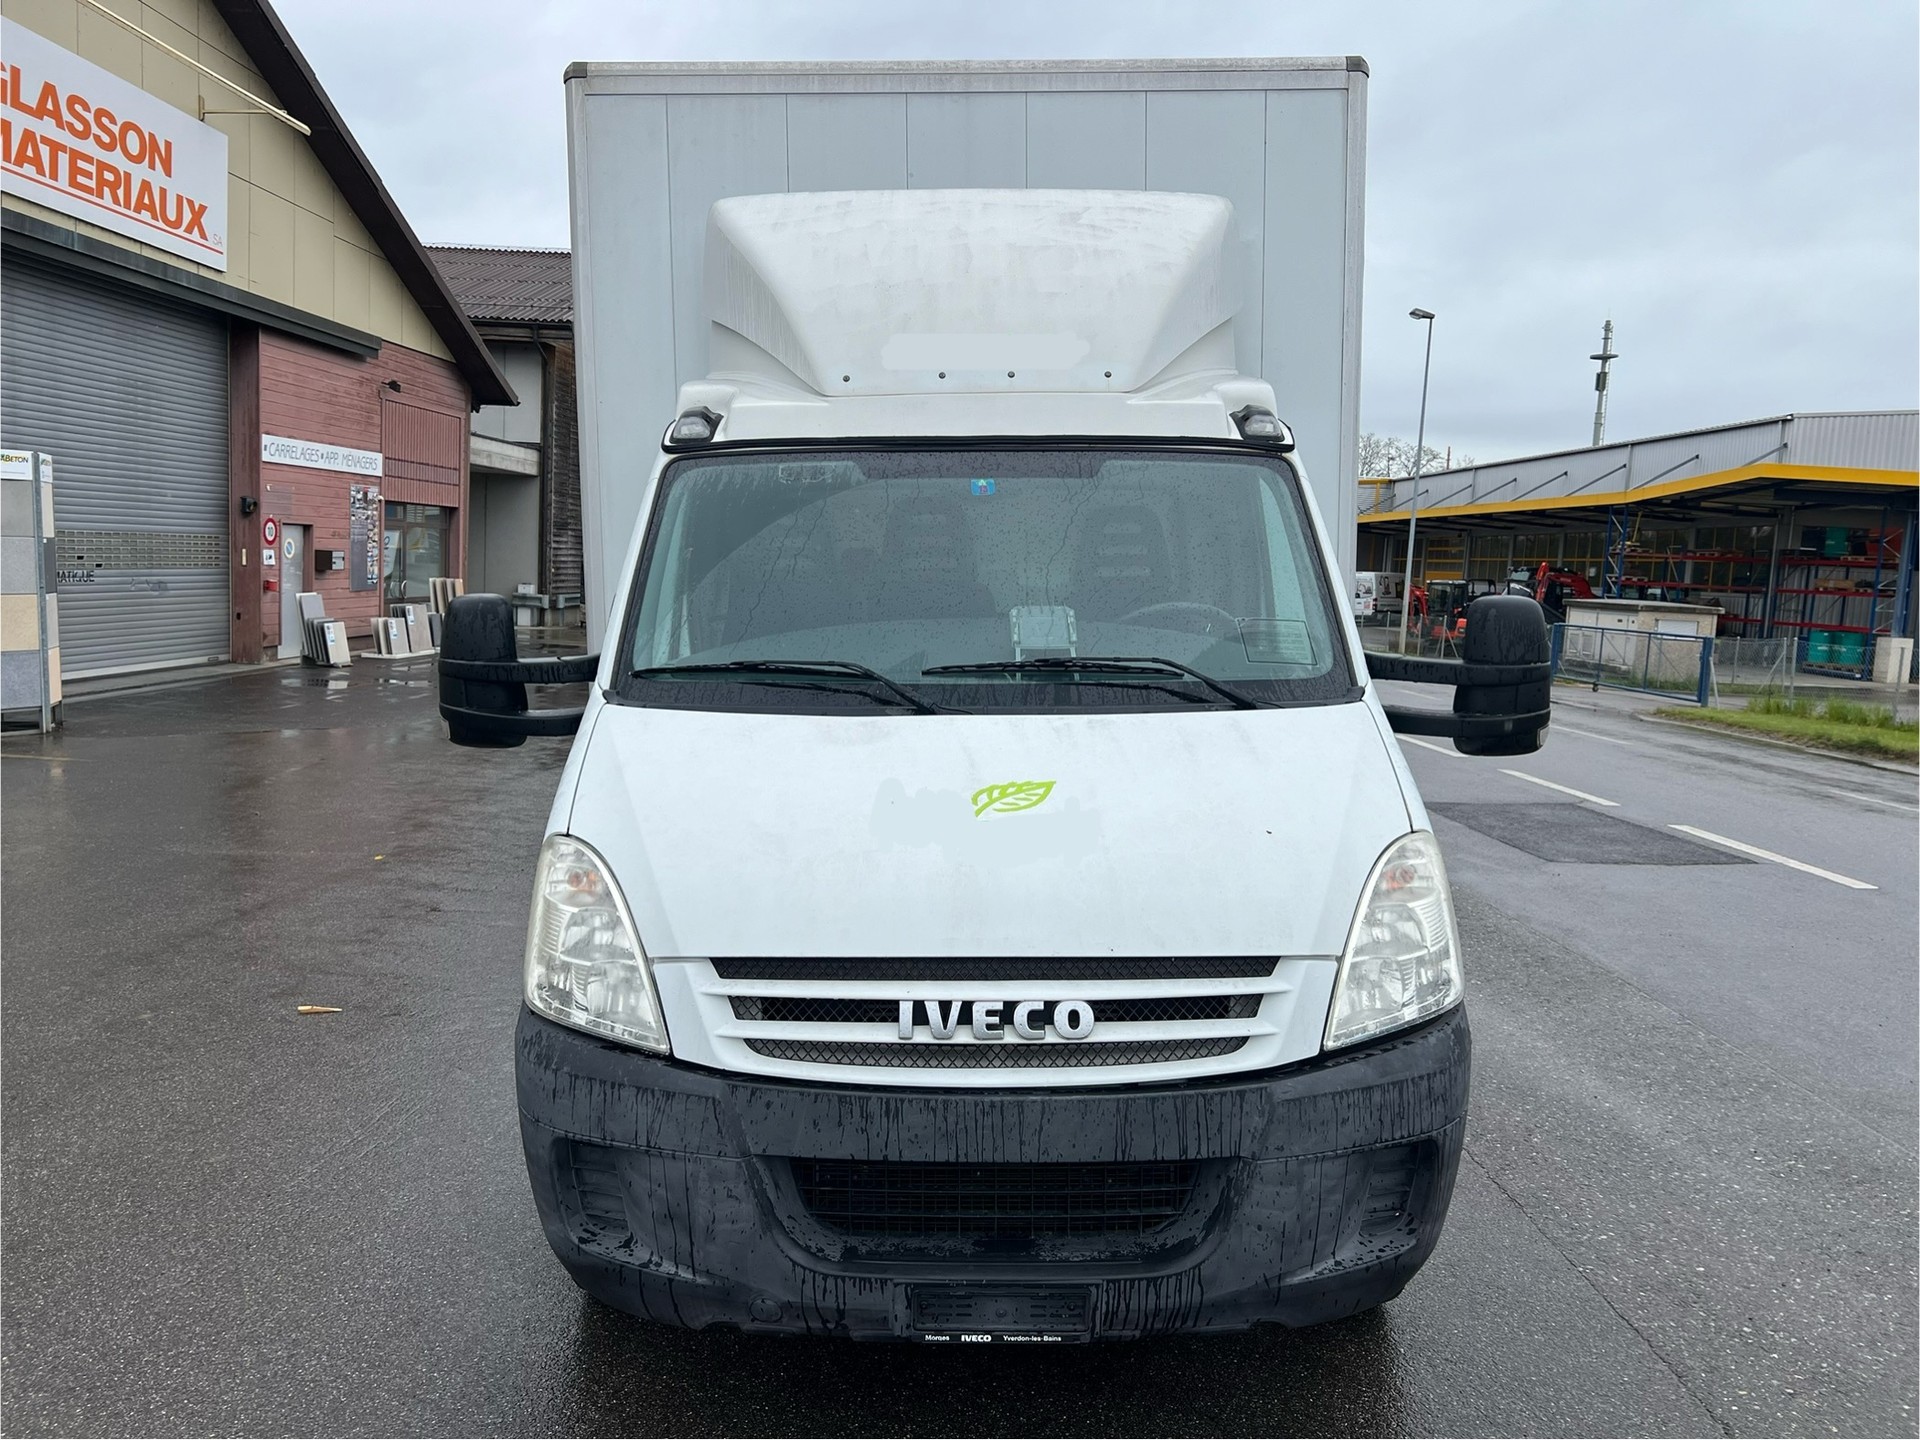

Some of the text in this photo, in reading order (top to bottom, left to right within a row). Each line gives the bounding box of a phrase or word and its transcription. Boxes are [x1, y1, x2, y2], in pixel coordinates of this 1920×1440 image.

[1, 61, 173, 178] LASSON
[212, 233, 223, 247] SA
[268, 442, 320, 463] CARRELAGES
[324, 451, 339, 466] APP.
[898, 1000, 1095, 1040] IVECO
[961, 1334, 992, 1342] IVECO
